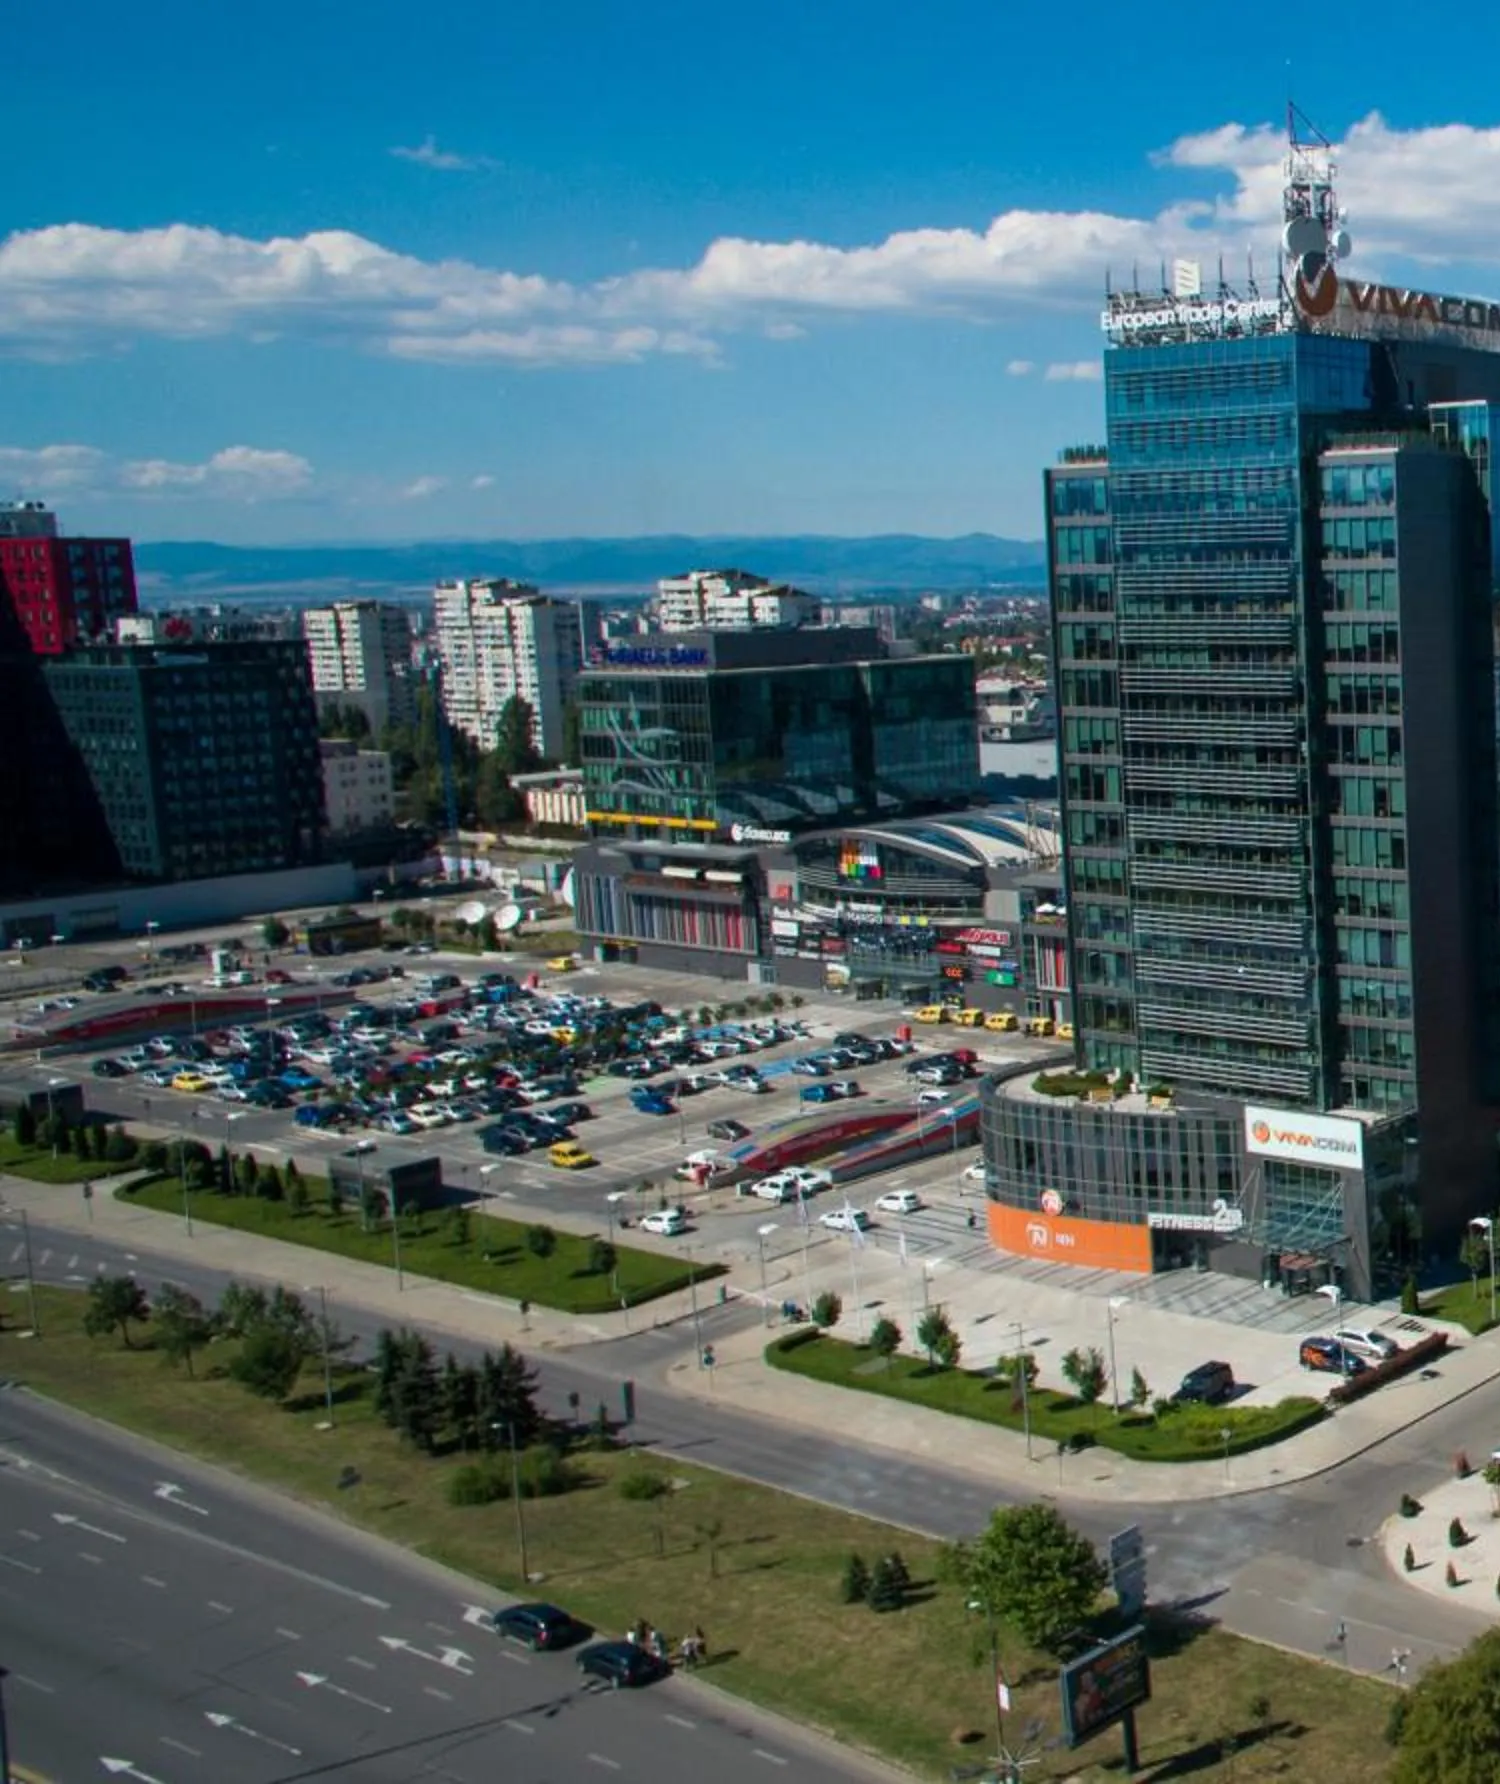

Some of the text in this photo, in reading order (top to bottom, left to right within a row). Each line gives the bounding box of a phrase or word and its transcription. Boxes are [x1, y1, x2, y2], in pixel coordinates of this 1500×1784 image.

[1101, 310, 1176, 331] European
[1177, 302, 1222, 322] Trade
[1274, 1129, 1357, 1154] VIVACOM
